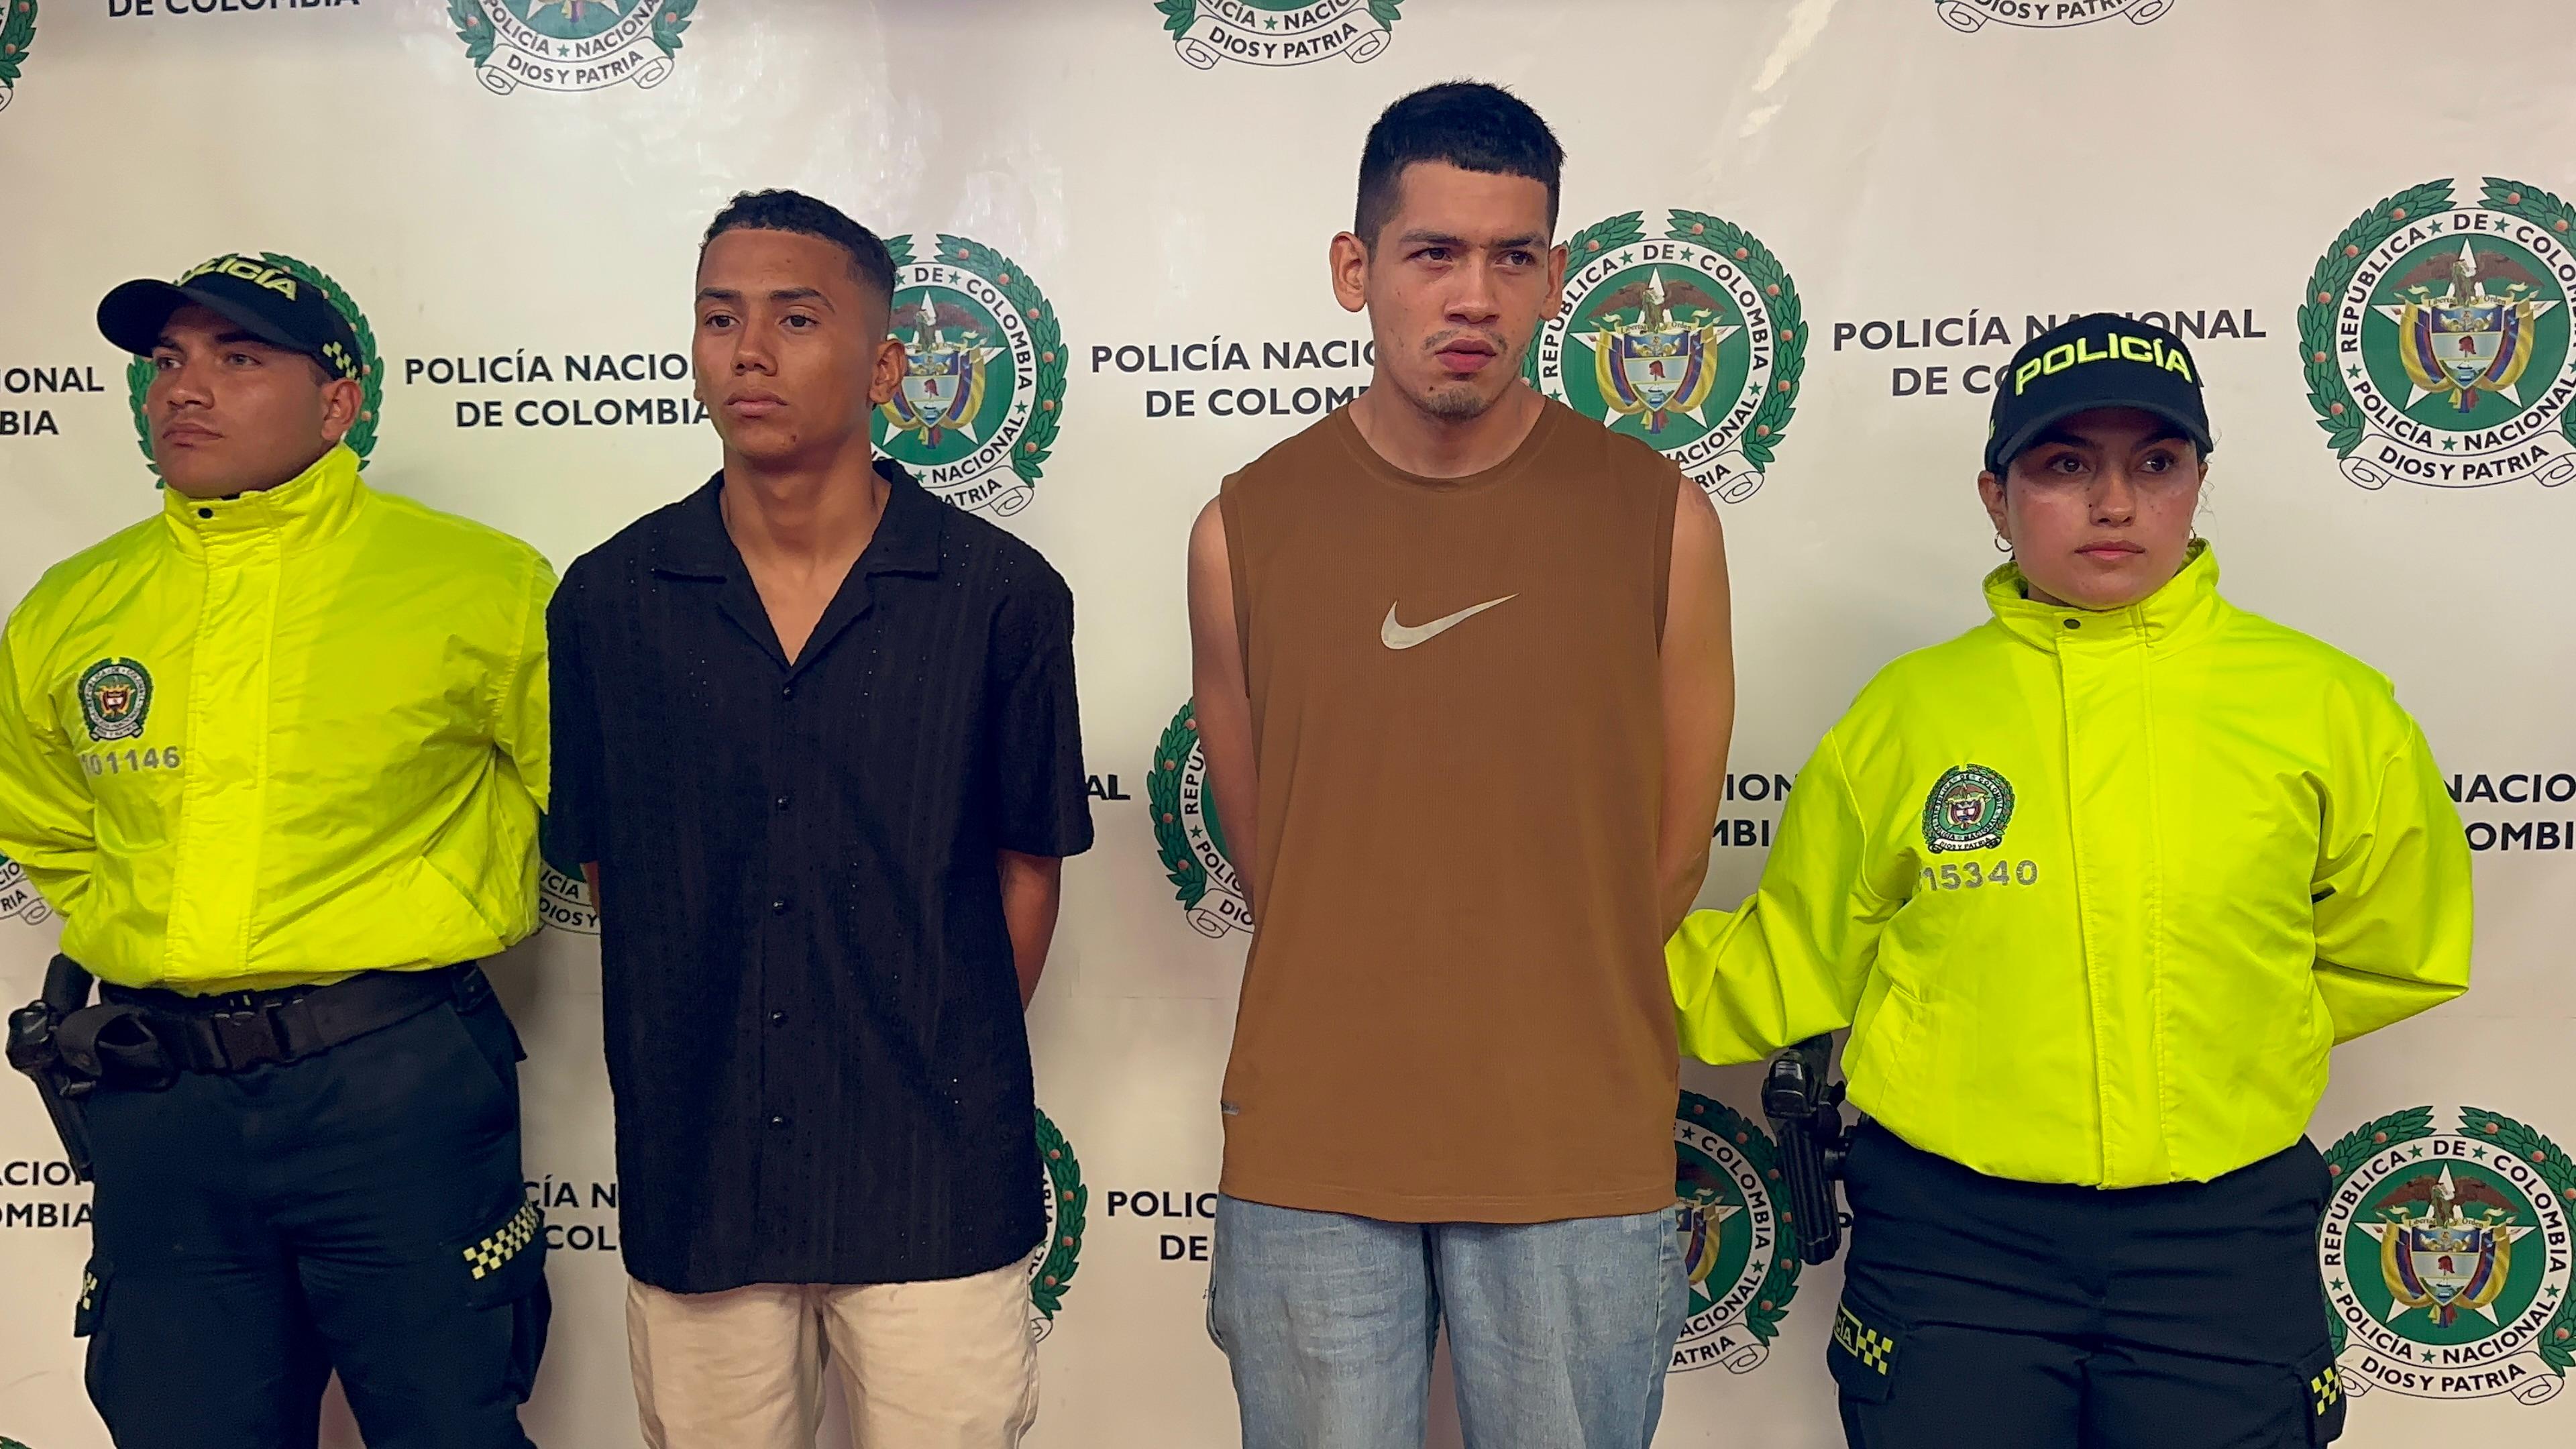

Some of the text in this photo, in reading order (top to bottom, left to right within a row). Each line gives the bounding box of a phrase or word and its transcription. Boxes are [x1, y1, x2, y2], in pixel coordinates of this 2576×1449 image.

[2035, 4, 2049, 20] Y
[1209, 22, 1358, 58] DIOS Y PATRIA
[507, 51, 644, 85] DIOS Y PATRIA
[2454, 213, 2488, 231] DE
[1644, 244, 1675, 260] DE
[1700, 255, 1769, 371] COLOMBIA
[915, 268, 1033, 390] DE COLOMBIA
[1833, 309, 2011, 352] POLICÍA
[405, 348, 696, 384] POLICÍA NACIO
[1091, 335, 1250, 373] POLICÍA
[2015, 332, 2193, 396] POLICÍA
[1892, 366, 1947, 396] DE
[456, 400, 503, 427] DE
[1146, 386, 1371, 418] DE COLOM
[2353, 377, 2576, 451] POLICÍA NACIONAL
[1666, 397, 1759, 464] ACIONAL
[932, 416, 1026, 484] NACIONAL
[2378, 443, 2550, 481] DIOS Y PATRIA
[1690, 464, 1731, 488] RIA
[586, 914, 598, 928] Y
[1701, 1136, 1770, 1250] COLOMBIA
[2434, 1140, 2467, 1157] DE
[2493, 1155, 2567, 1273] COLOMBIA
[0, 1203, 93, 1228] MBIA
[1161, 1234, 1208, 1261] DE
[2336, 1294, 2557, 1364] POLICÍA NACIONAL
[2361, 1356, 2526, 1393] DIOS Y PATRIA
